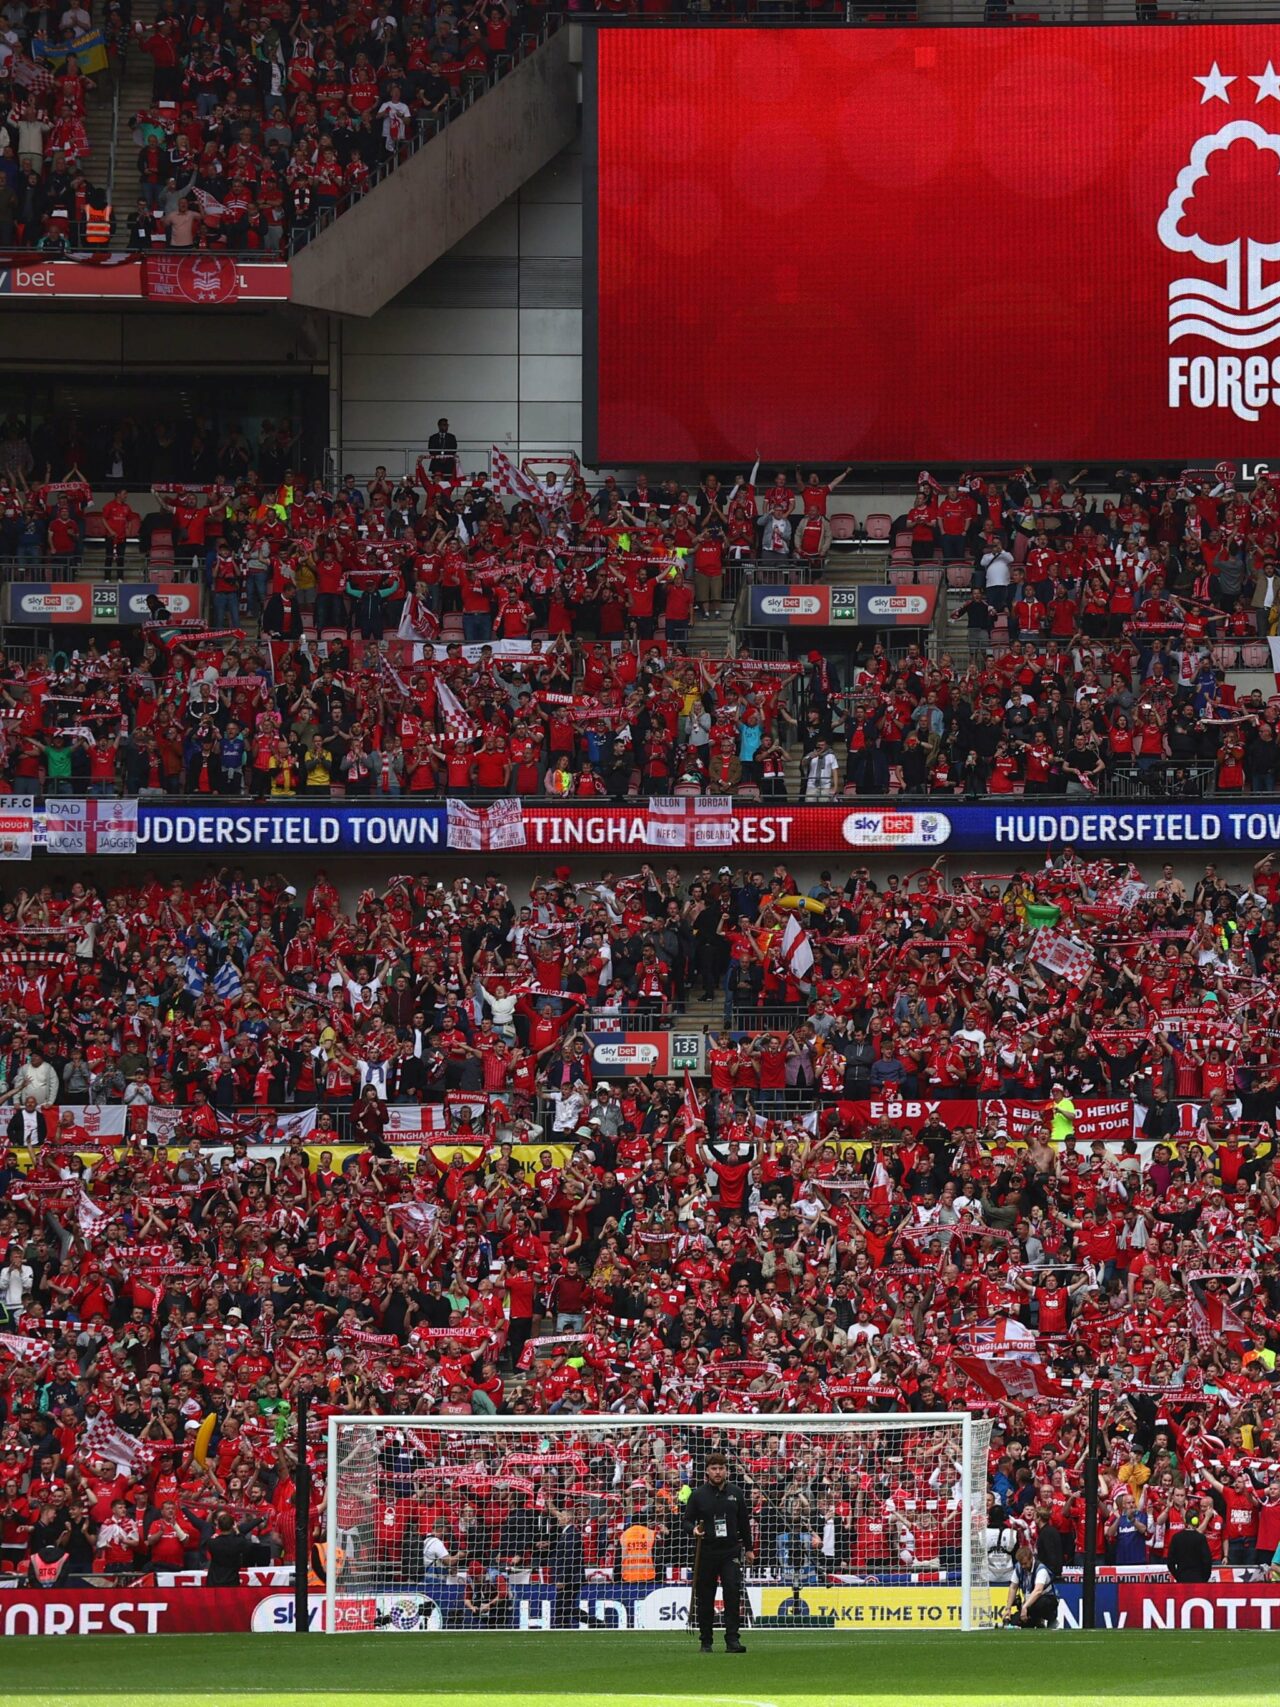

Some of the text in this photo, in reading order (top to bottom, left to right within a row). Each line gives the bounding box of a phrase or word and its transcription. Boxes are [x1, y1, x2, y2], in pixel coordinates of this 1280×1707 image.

[16, 269, 55, 286] bet
[1242, 463, 1269, 480] LG
[28, 597, 61, 607] sky bet
[95, 592, 116, 604] 238
[768, 598, 800, 608] sky bet
[833, 594, 855, 605] 239
[874, 598, 907, 608] sky bet
[50, 803, 82, 815] DAD
[698, 798, 729, 808] JORDAN
[64, 820, 119, 833] NFFC
[137, 817, 340, 844] UDDERSFIELD
[348, 817, 439, 844] TOWN
[522, 817, 793, 844] TINGHA REST
[854, 816, 911, 833] sky bet
[995, 814, 1220, 841] HUDDERSFIELD
[656, 828, 677, 839] NFFC
[695, 830, 731, 841] ENGLAND
[922, 834, 937, 842] EFL
[50, 838, 136, 850] LUCAS JAGGER
[601, 1046, 636, 1056] sky bet
[675, 1042, 697, 1053] 133
[870, 1101, 941, 1119] EBBY
[1013, 1102, 1129, 1119] EBB HEIKE
[1013, 1119, 1129, 1134] WIH ON TOUR
[383, 1131, 432, 1140] OTTINGHAM
[115, 1245, 163, 1257] NFFC
[428, 1327, 477, 1336] NOTTINGHAM
[0, 1603, 168, 1635] OREST
[819, 1606, 863, 1621] TAKE
[869, 1606, 913, 1621] TIME
[917, 1606, 942, 1621] TO
